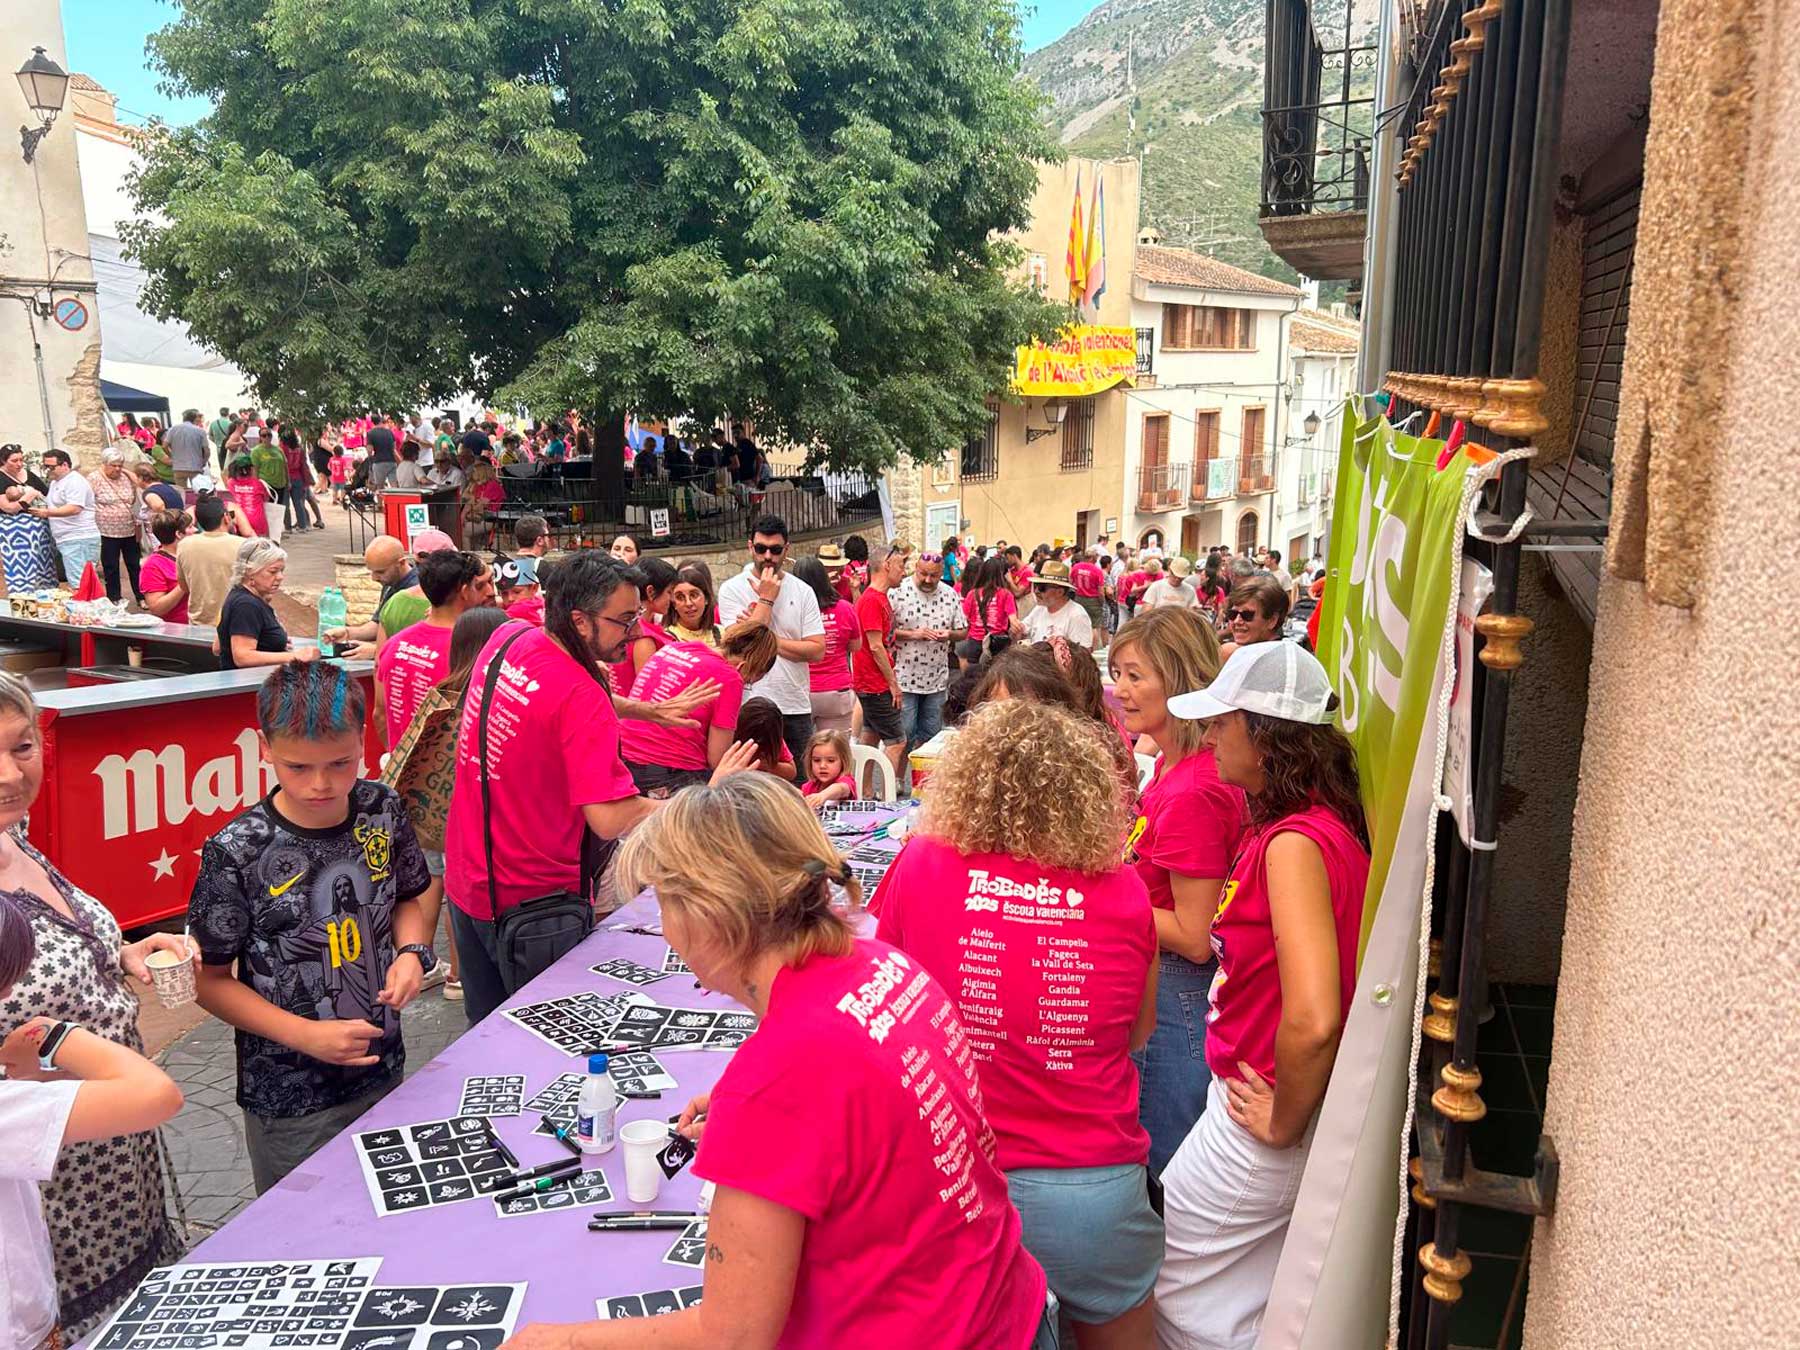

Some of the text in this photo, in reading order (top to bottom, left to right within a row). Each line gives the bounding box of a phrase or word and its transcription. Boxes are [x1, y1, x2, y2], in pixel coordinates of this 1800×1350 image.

[92, 727, 370, 840] Mah
[1036, 906, 1085, 920] valenciana
[327, 918, 361, 968] 10
[958, 936, 1007, 951] de Malferit
[1037, 936, 1089, 948] El Campello
[963, 950, 998, 963] Alacant
[1049, 949, 1080, 961] Fageca
[958, 963, 1002, 978] Albuixech
[1031, 958, 1094, 971] la Vall de Seta
[1042, 971, 1086, 984] Fortaleny
[961, 987, 997, 1000] d'Alfara
[1048, 984, 1081, 995] Gandia
[1038, 996, 1090, 1007] Guardamar
[1038, 1010, 1089, 1023] L'Alguenya
[1041, 1024, 1086, 1035] Picassent
[1047, 1047, 1072, 1058] Serra
[1045, 1060, 1074, 1071] Xàtiva
[901, 1074, 912, 1088] de
